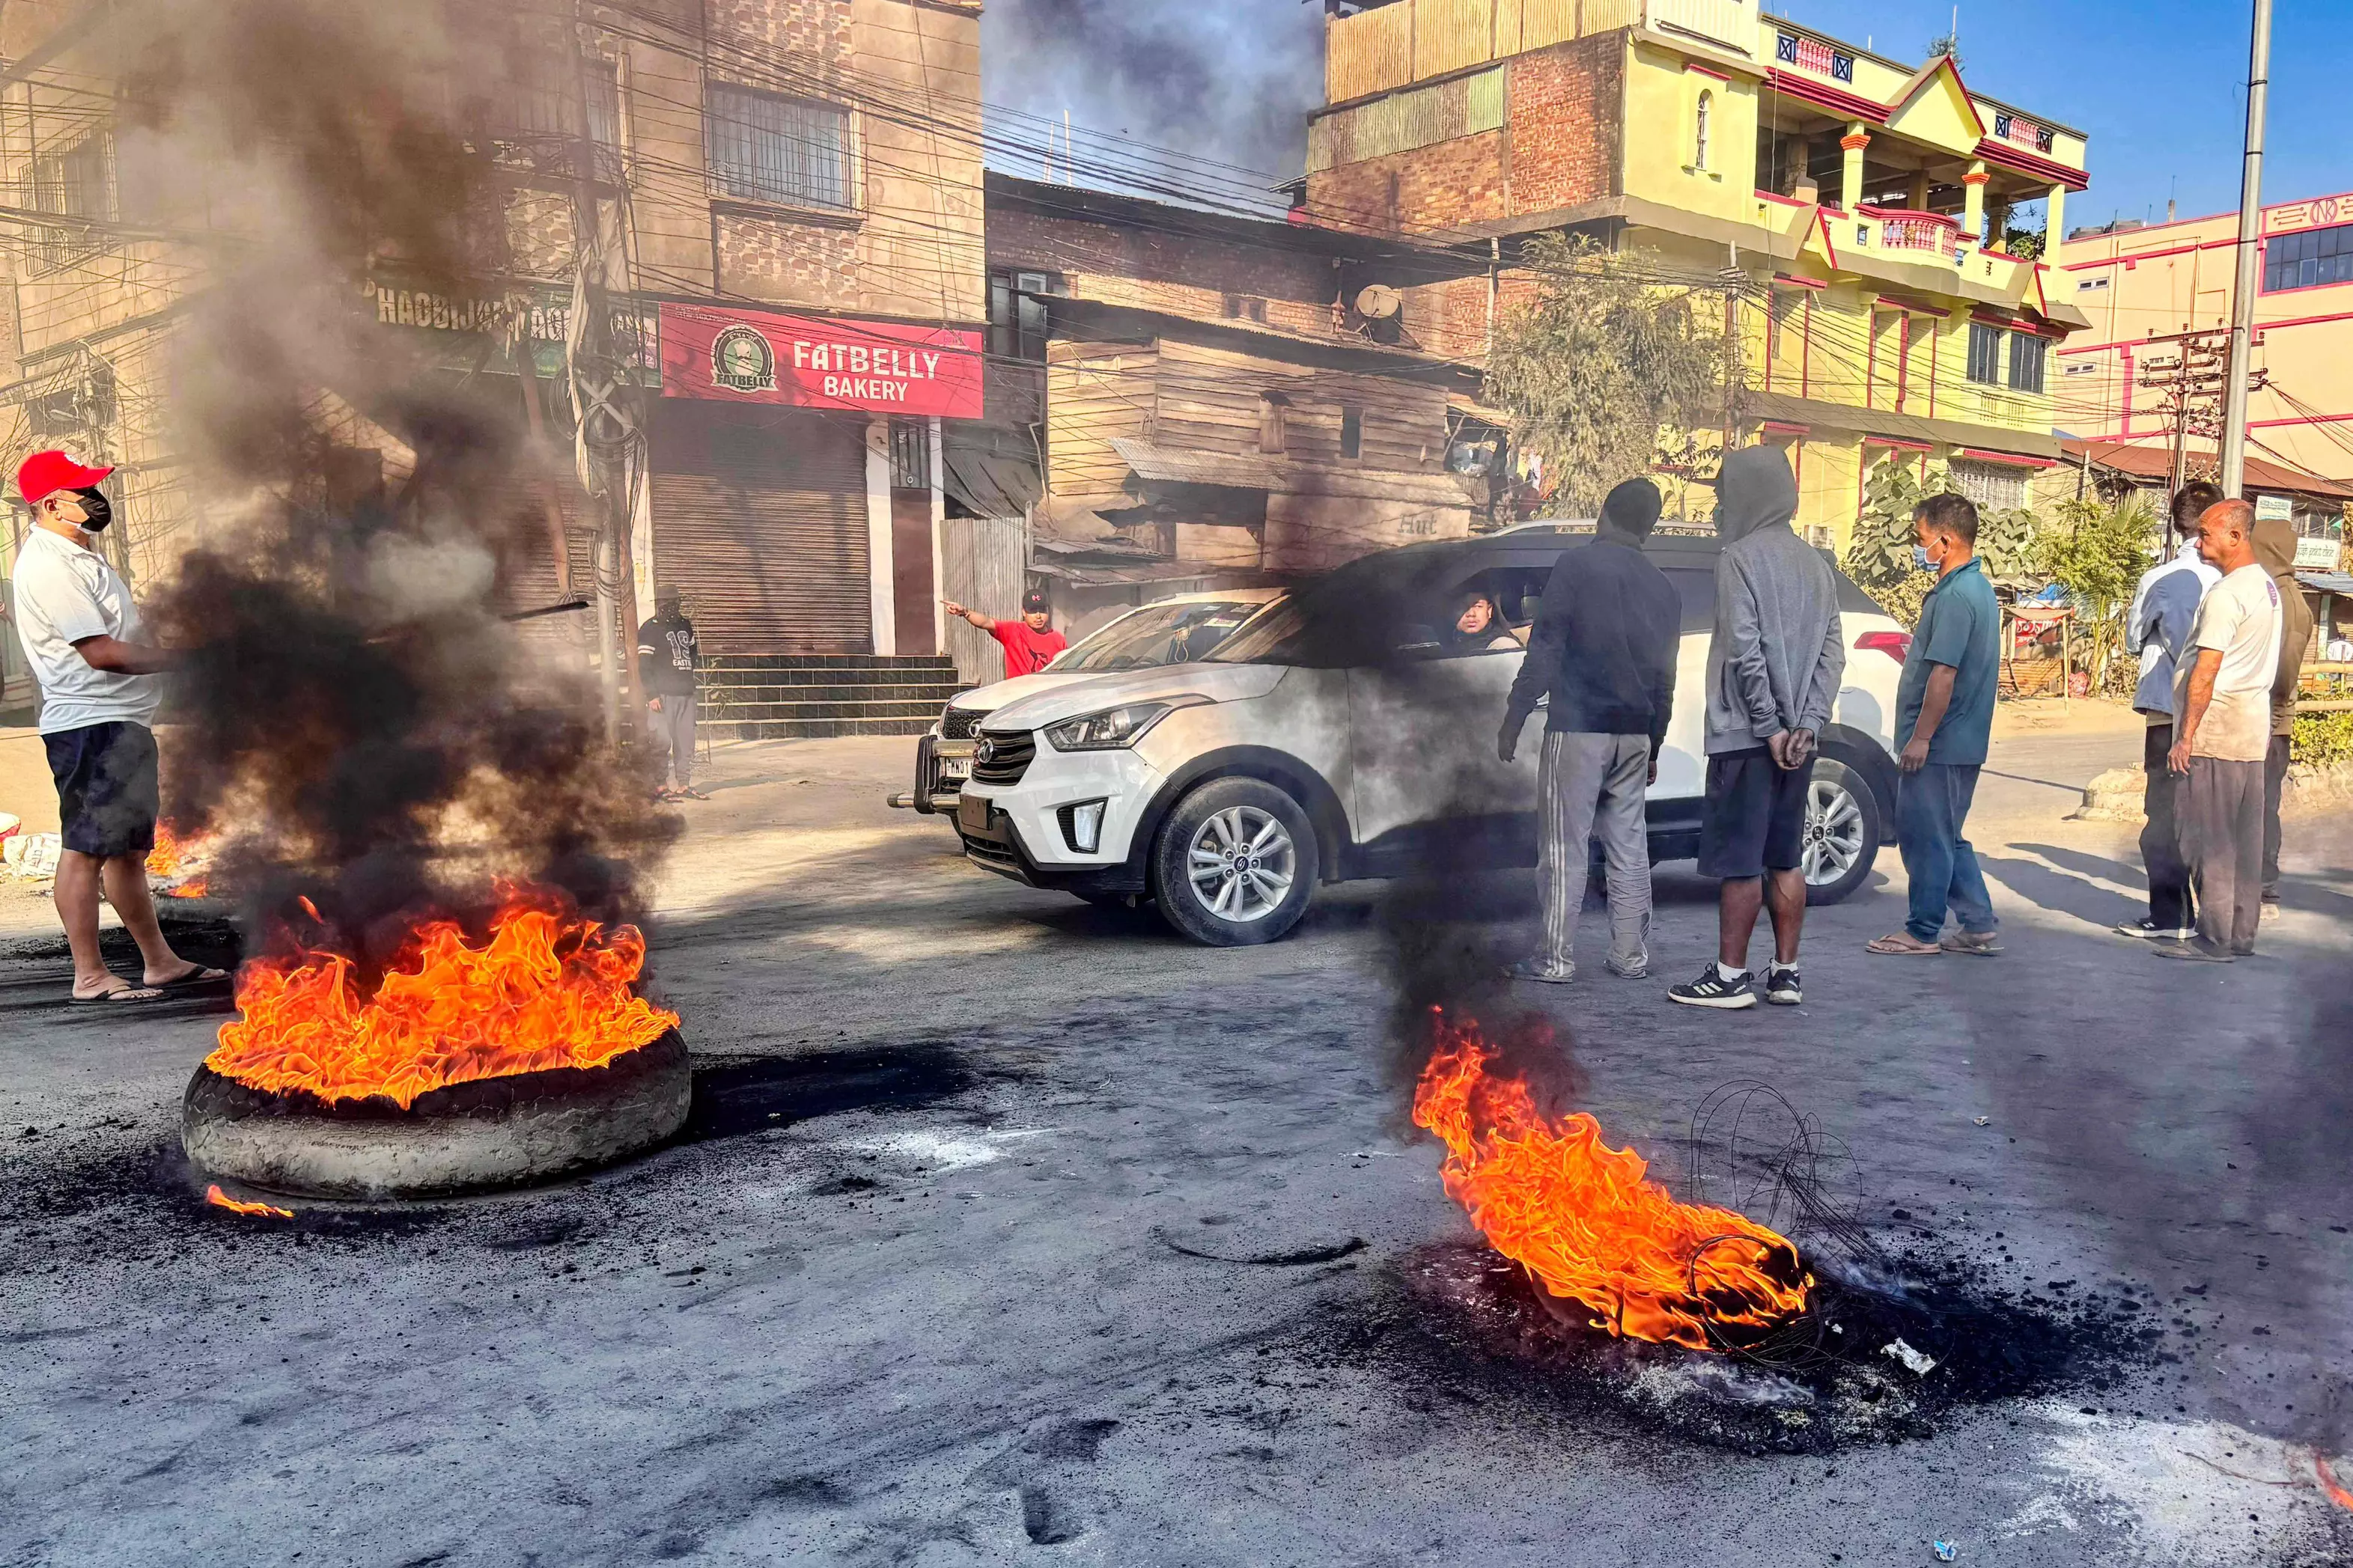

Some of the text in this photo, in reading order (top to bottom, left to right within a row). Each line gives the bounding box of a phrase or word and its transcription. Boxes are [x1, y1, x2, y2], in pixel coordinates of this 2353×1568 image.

[794, 341, 940, 379] FATBELLY
[717, 374, 771, 388] FATBELLY
[824, 376, 908, 402] BAKERY
[1398, 514, 1437, 534] Hut
